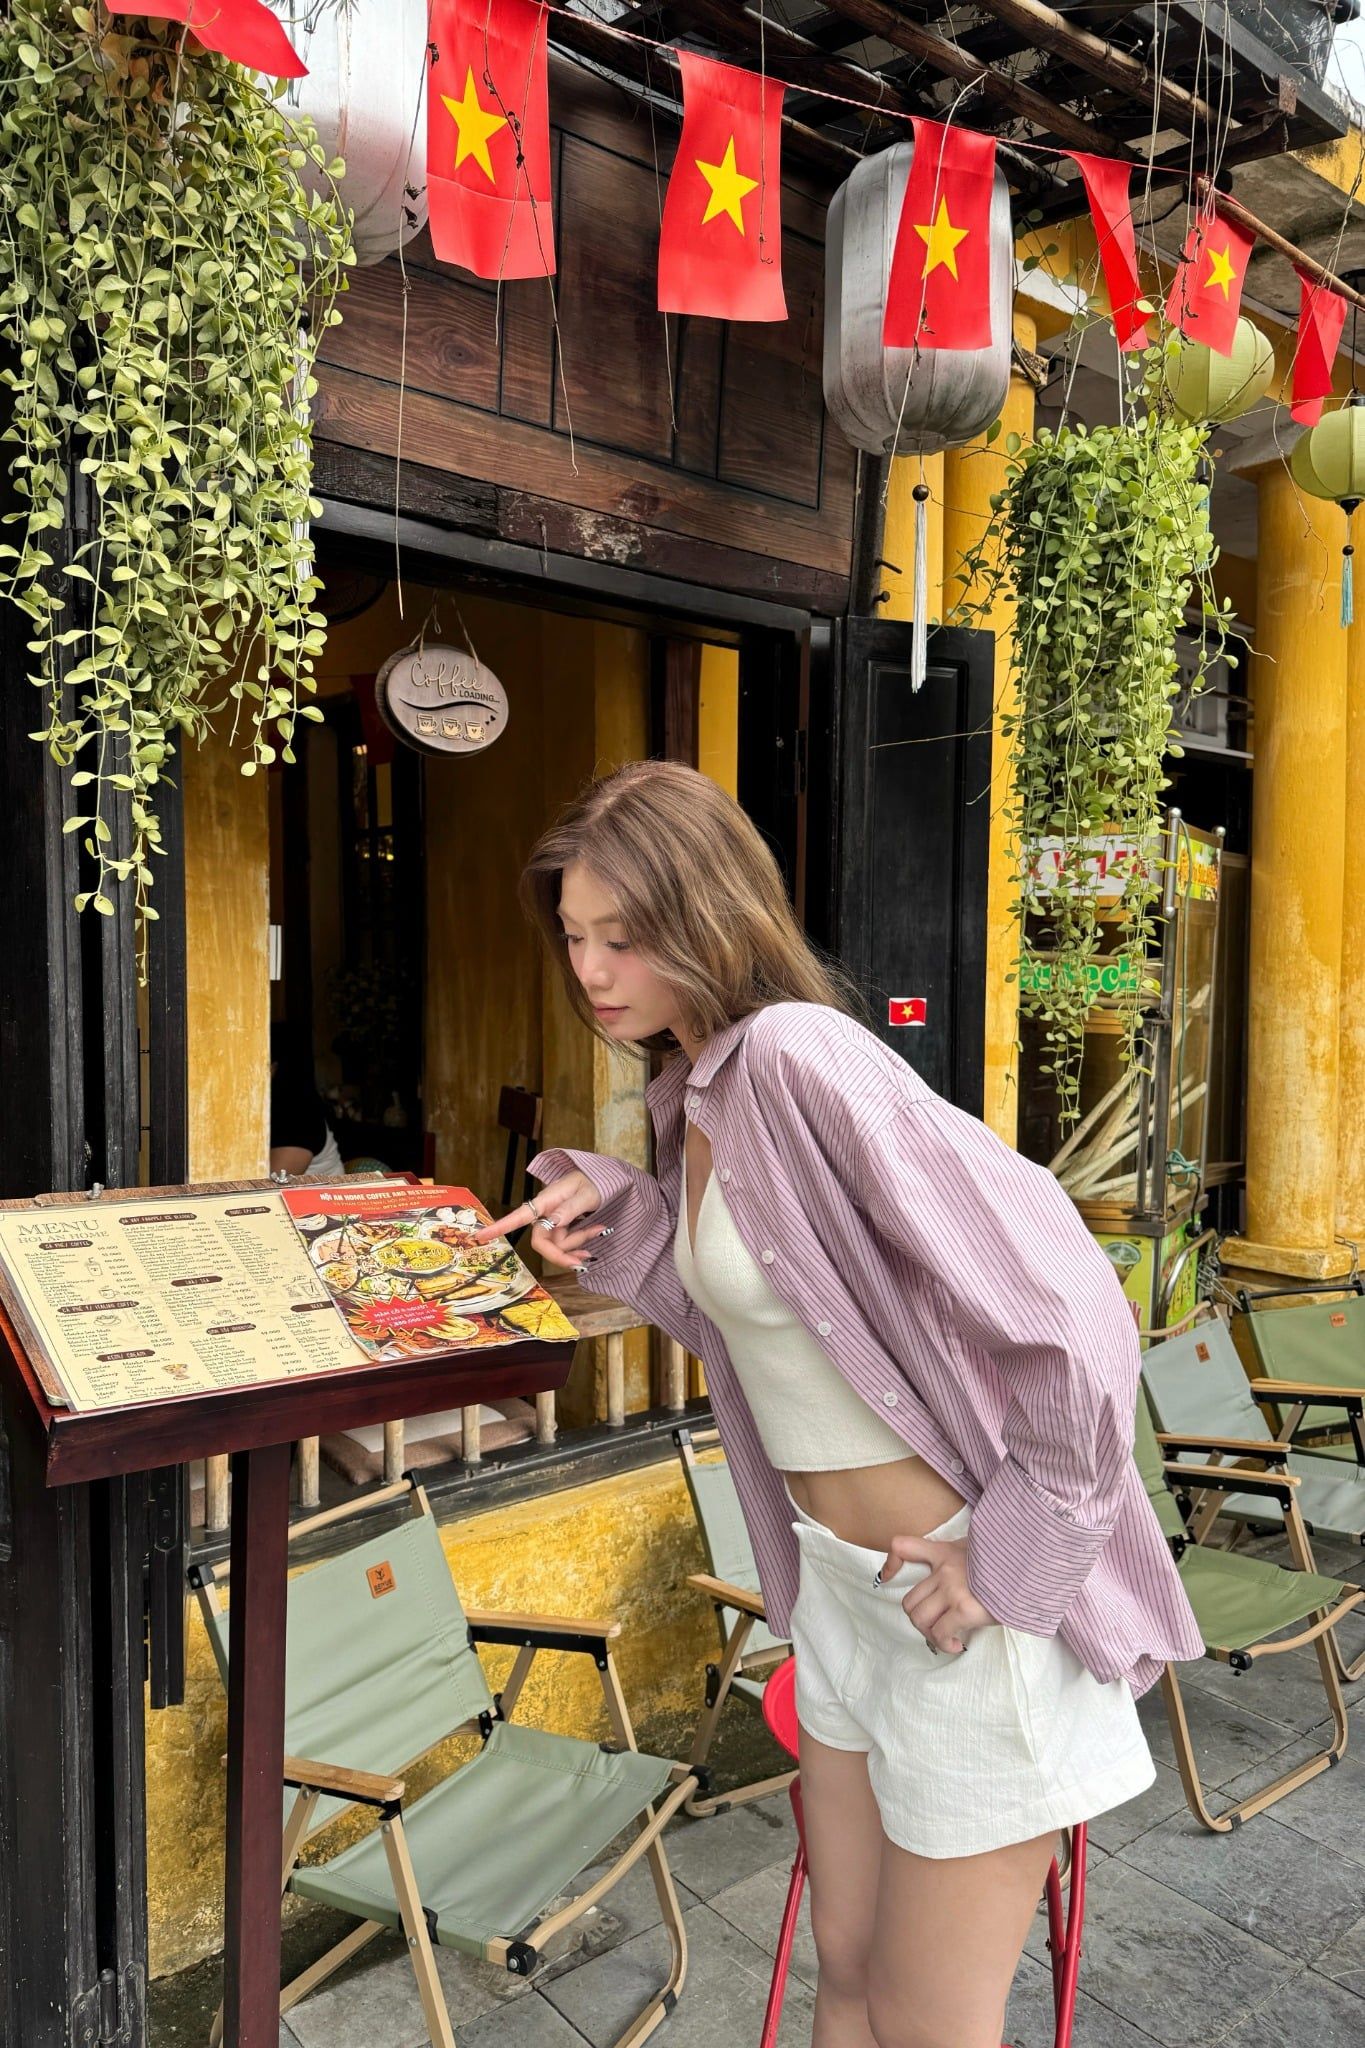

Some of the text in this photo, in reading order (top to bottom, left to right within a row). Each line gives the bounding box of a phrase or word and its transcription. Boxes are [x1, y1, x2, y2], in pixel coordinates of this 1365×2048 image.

[410, 660, 485, 697] Coffee
[367, 1192, 392, 1200] COFFEE
[16, 1219, 100, 1236] MENU
[68, 1231, 110, 1239] HOME
